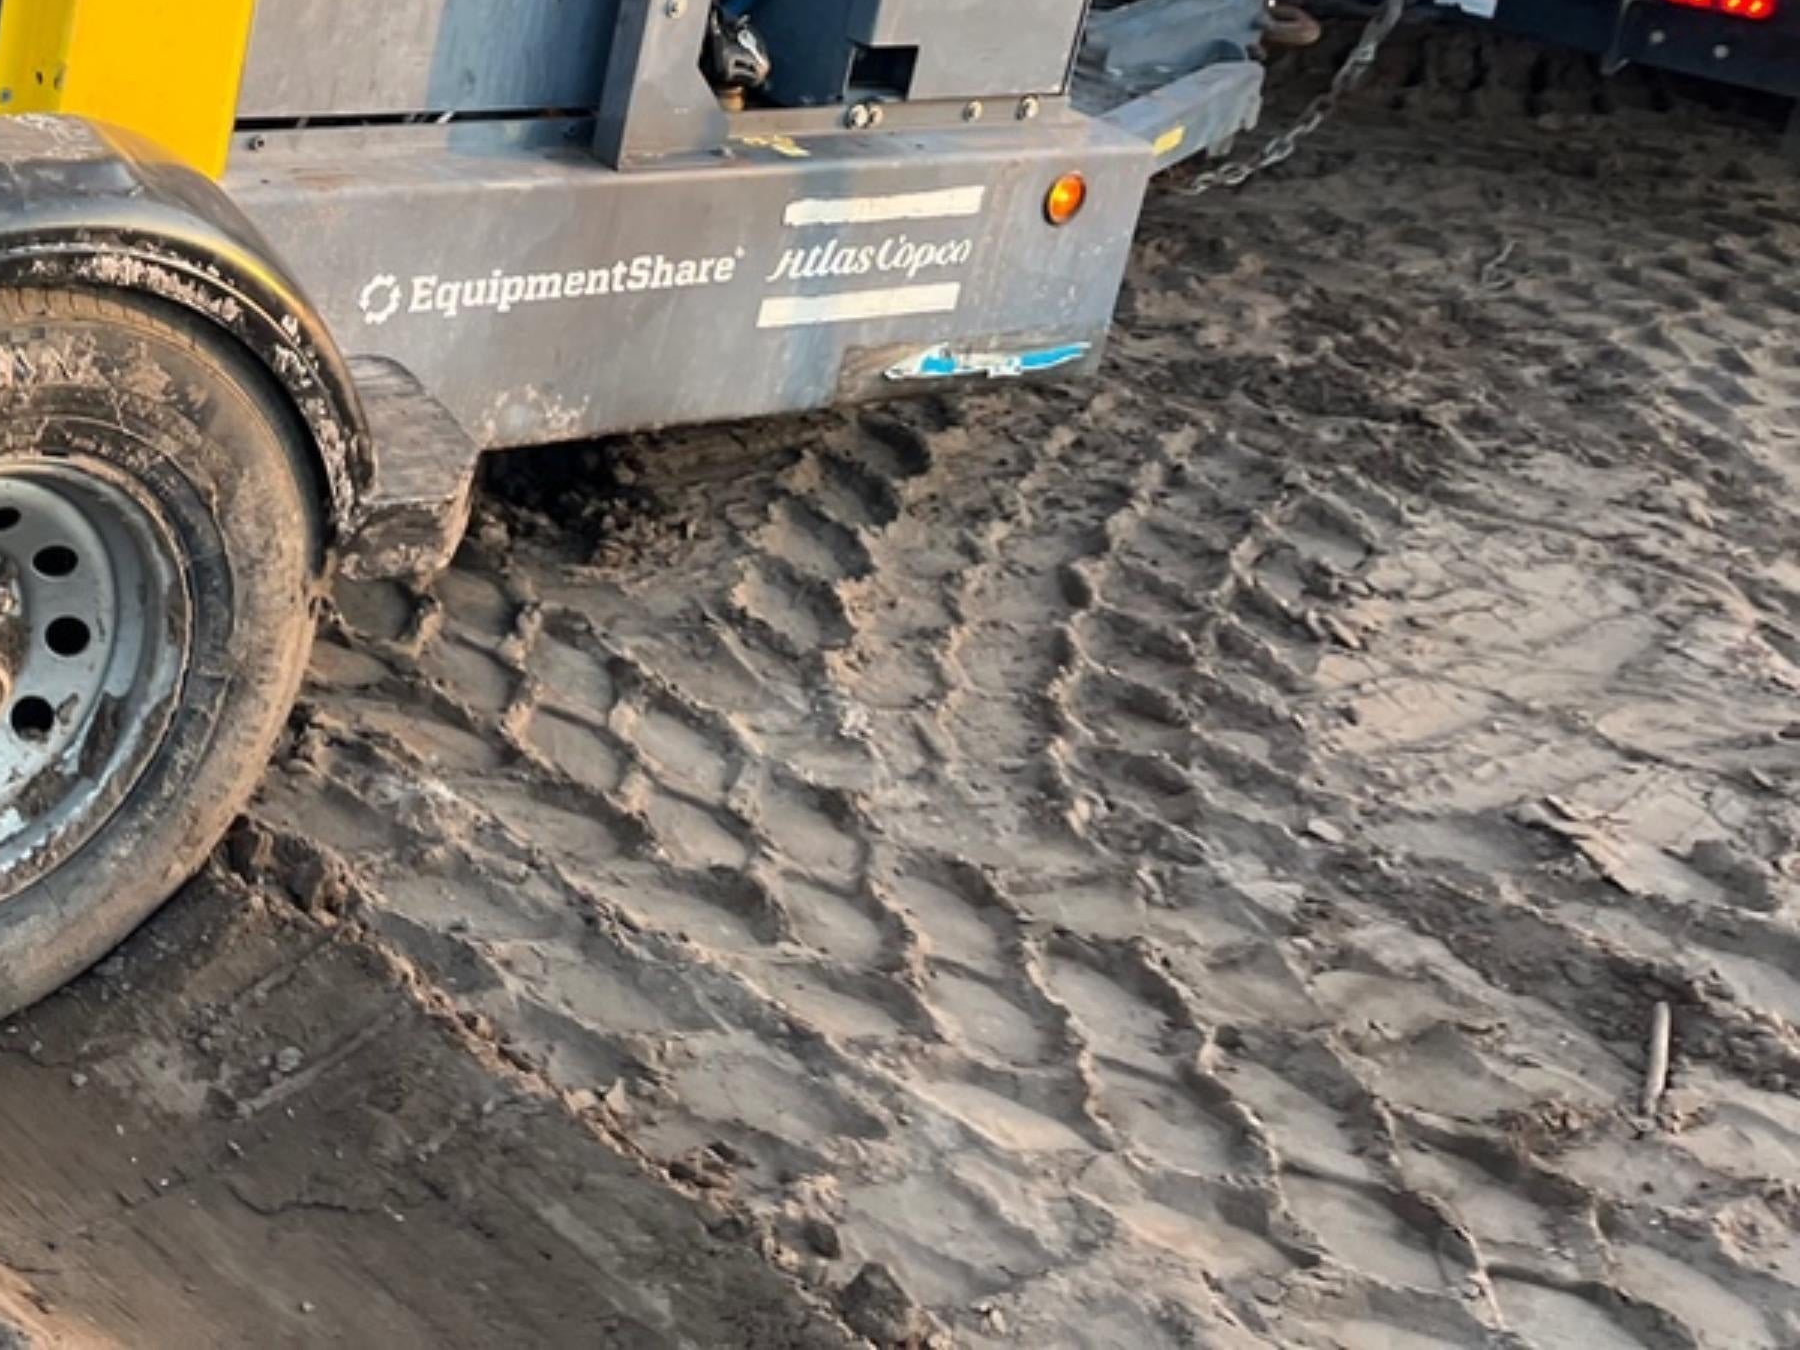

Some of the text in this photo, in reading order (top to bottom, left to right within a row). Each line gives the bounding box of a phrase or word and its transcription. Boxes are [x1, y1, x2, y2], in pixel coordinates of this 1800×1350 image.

[408, 253, 736, 318] EquipmentShare
[765, 234, 973, 282] Atlas Copco
